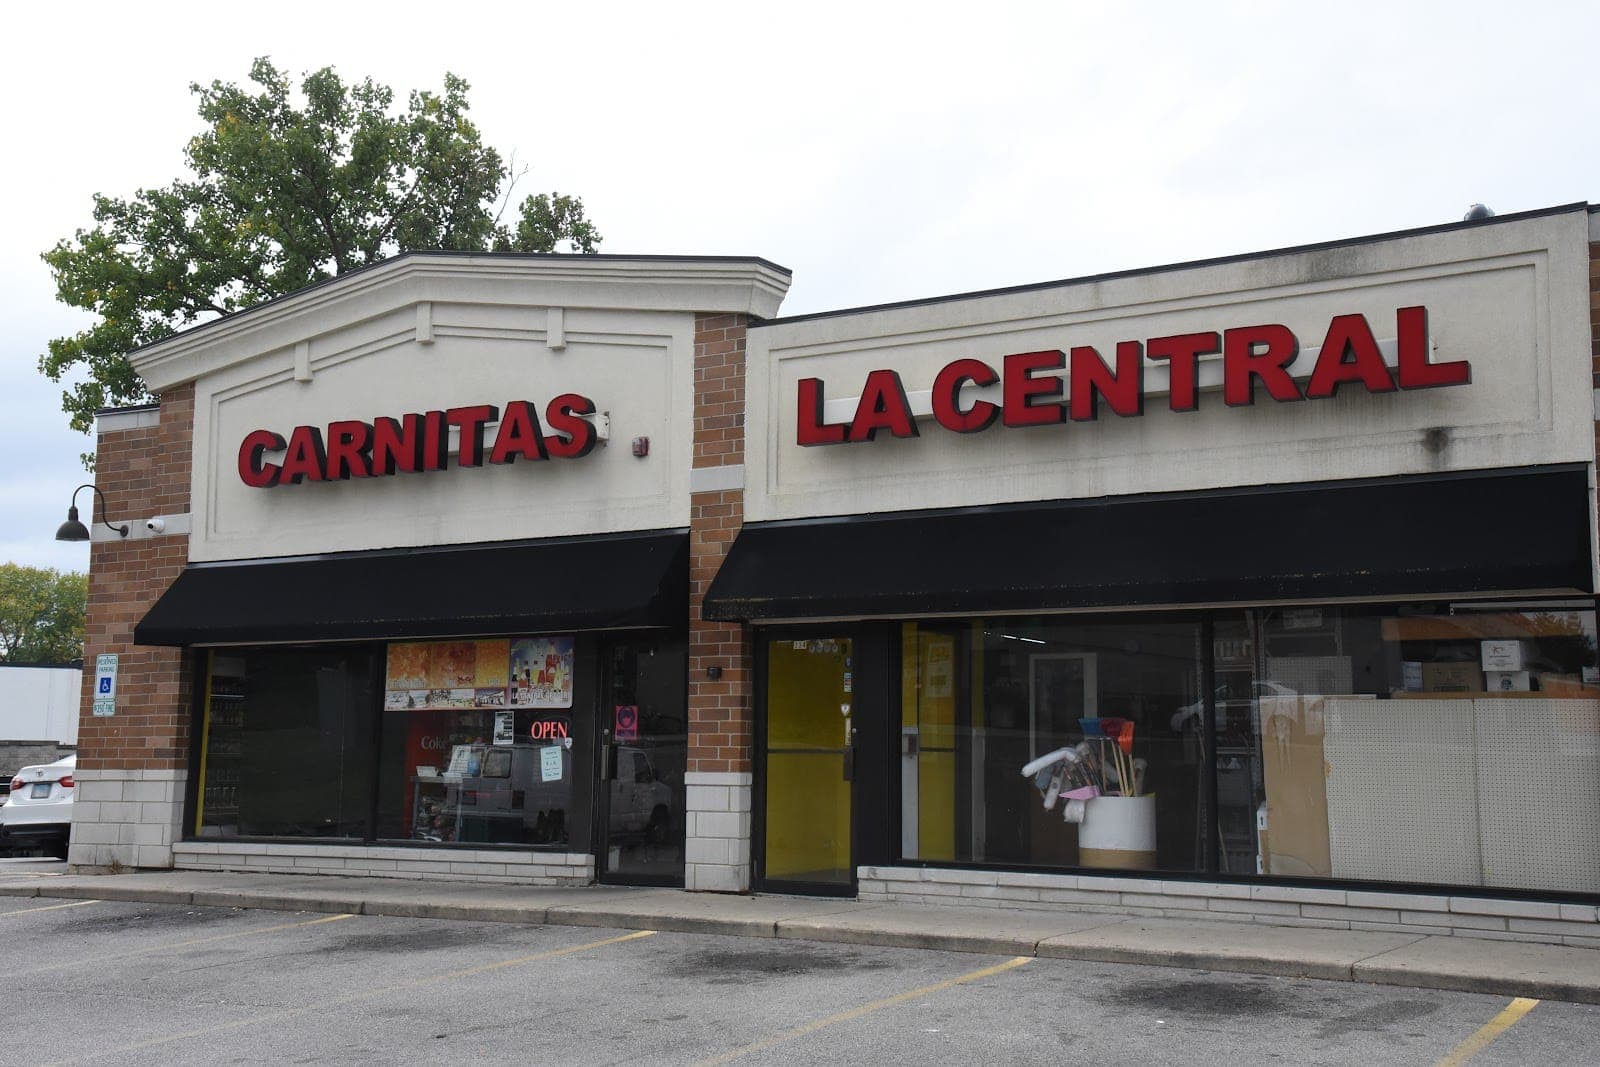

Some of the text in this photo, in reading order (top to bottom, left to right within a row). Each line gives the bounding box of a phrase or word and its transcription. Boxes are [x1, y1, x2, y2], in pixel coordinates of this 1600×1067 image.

[797, 305, 1471, 448] LA CENTRAL
[238, 393, 596, 488] CARNITAS
[531, 721, 568, 739] OPEN
